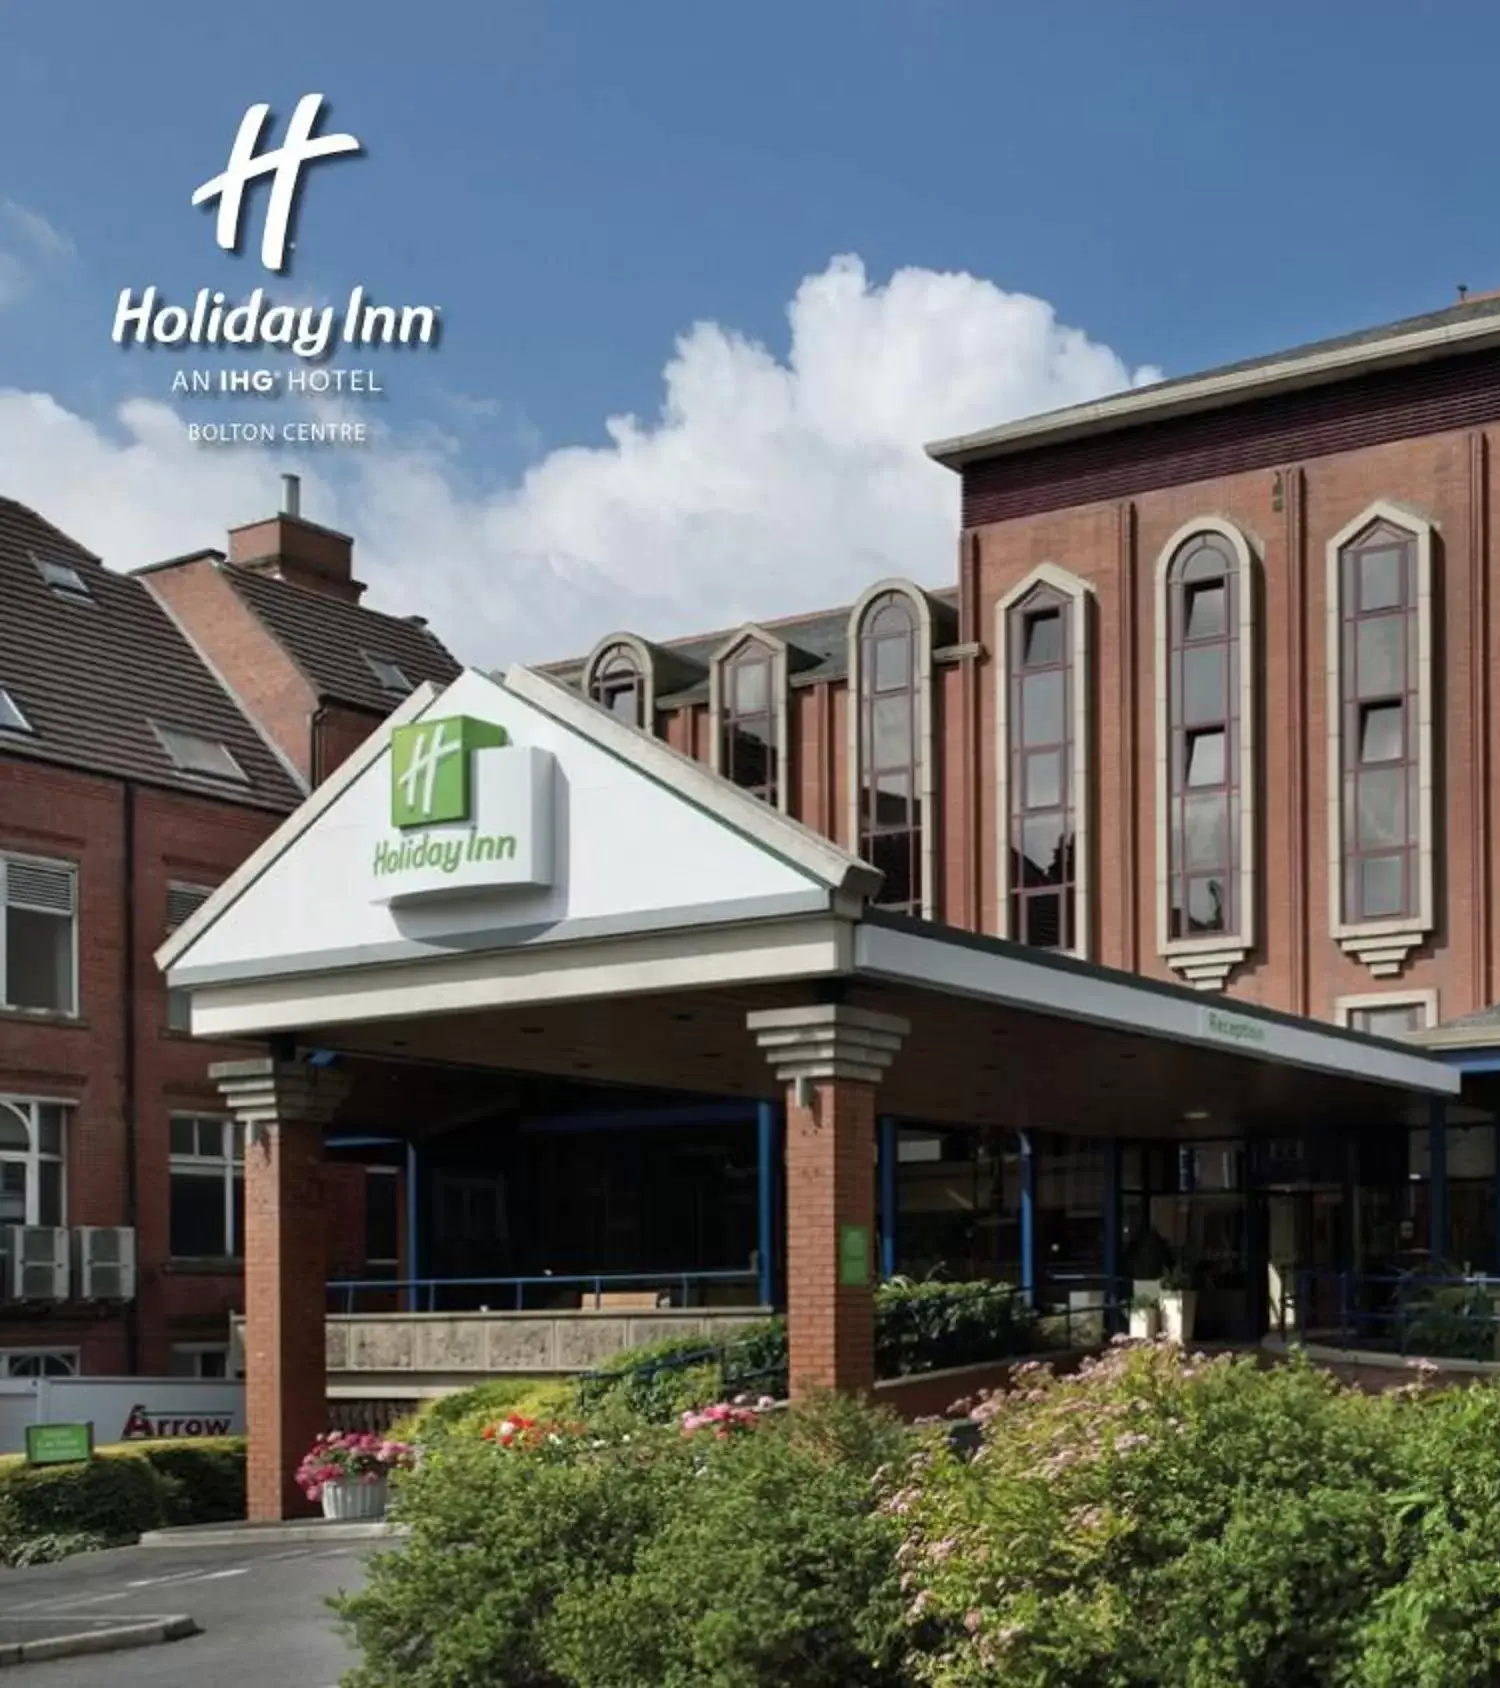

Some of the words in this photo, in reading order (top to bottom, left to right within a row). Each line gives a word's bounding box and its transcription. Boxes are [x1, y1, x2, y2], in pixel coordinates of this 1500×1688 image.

[373, 832, 464, 877] Holiday
[465, 824, 516, 862] Inn
[121, 1403, 233, 1440] Arrow
